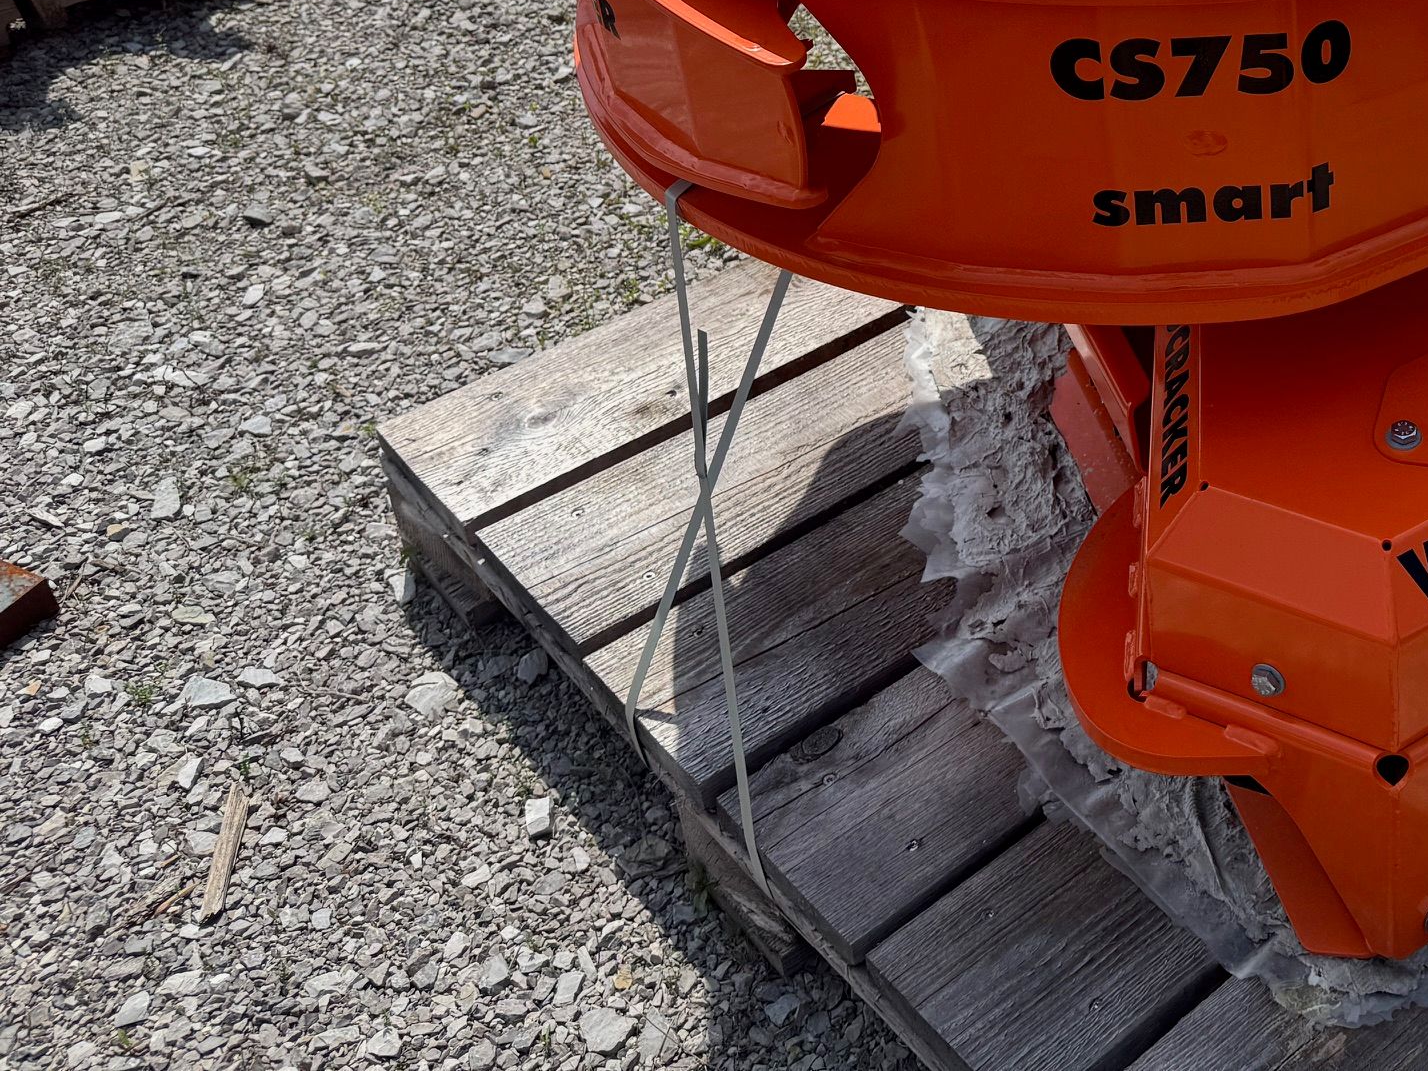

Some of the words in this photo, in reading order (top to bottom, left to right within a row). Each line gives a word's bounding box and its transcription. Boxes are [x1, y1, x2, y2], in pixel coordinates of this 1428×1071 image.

[1050, 19, 1351, 101] CS750
[1092, 161, 1334, 227] smart
[1159, 324, 1191, 510] CRACKER
